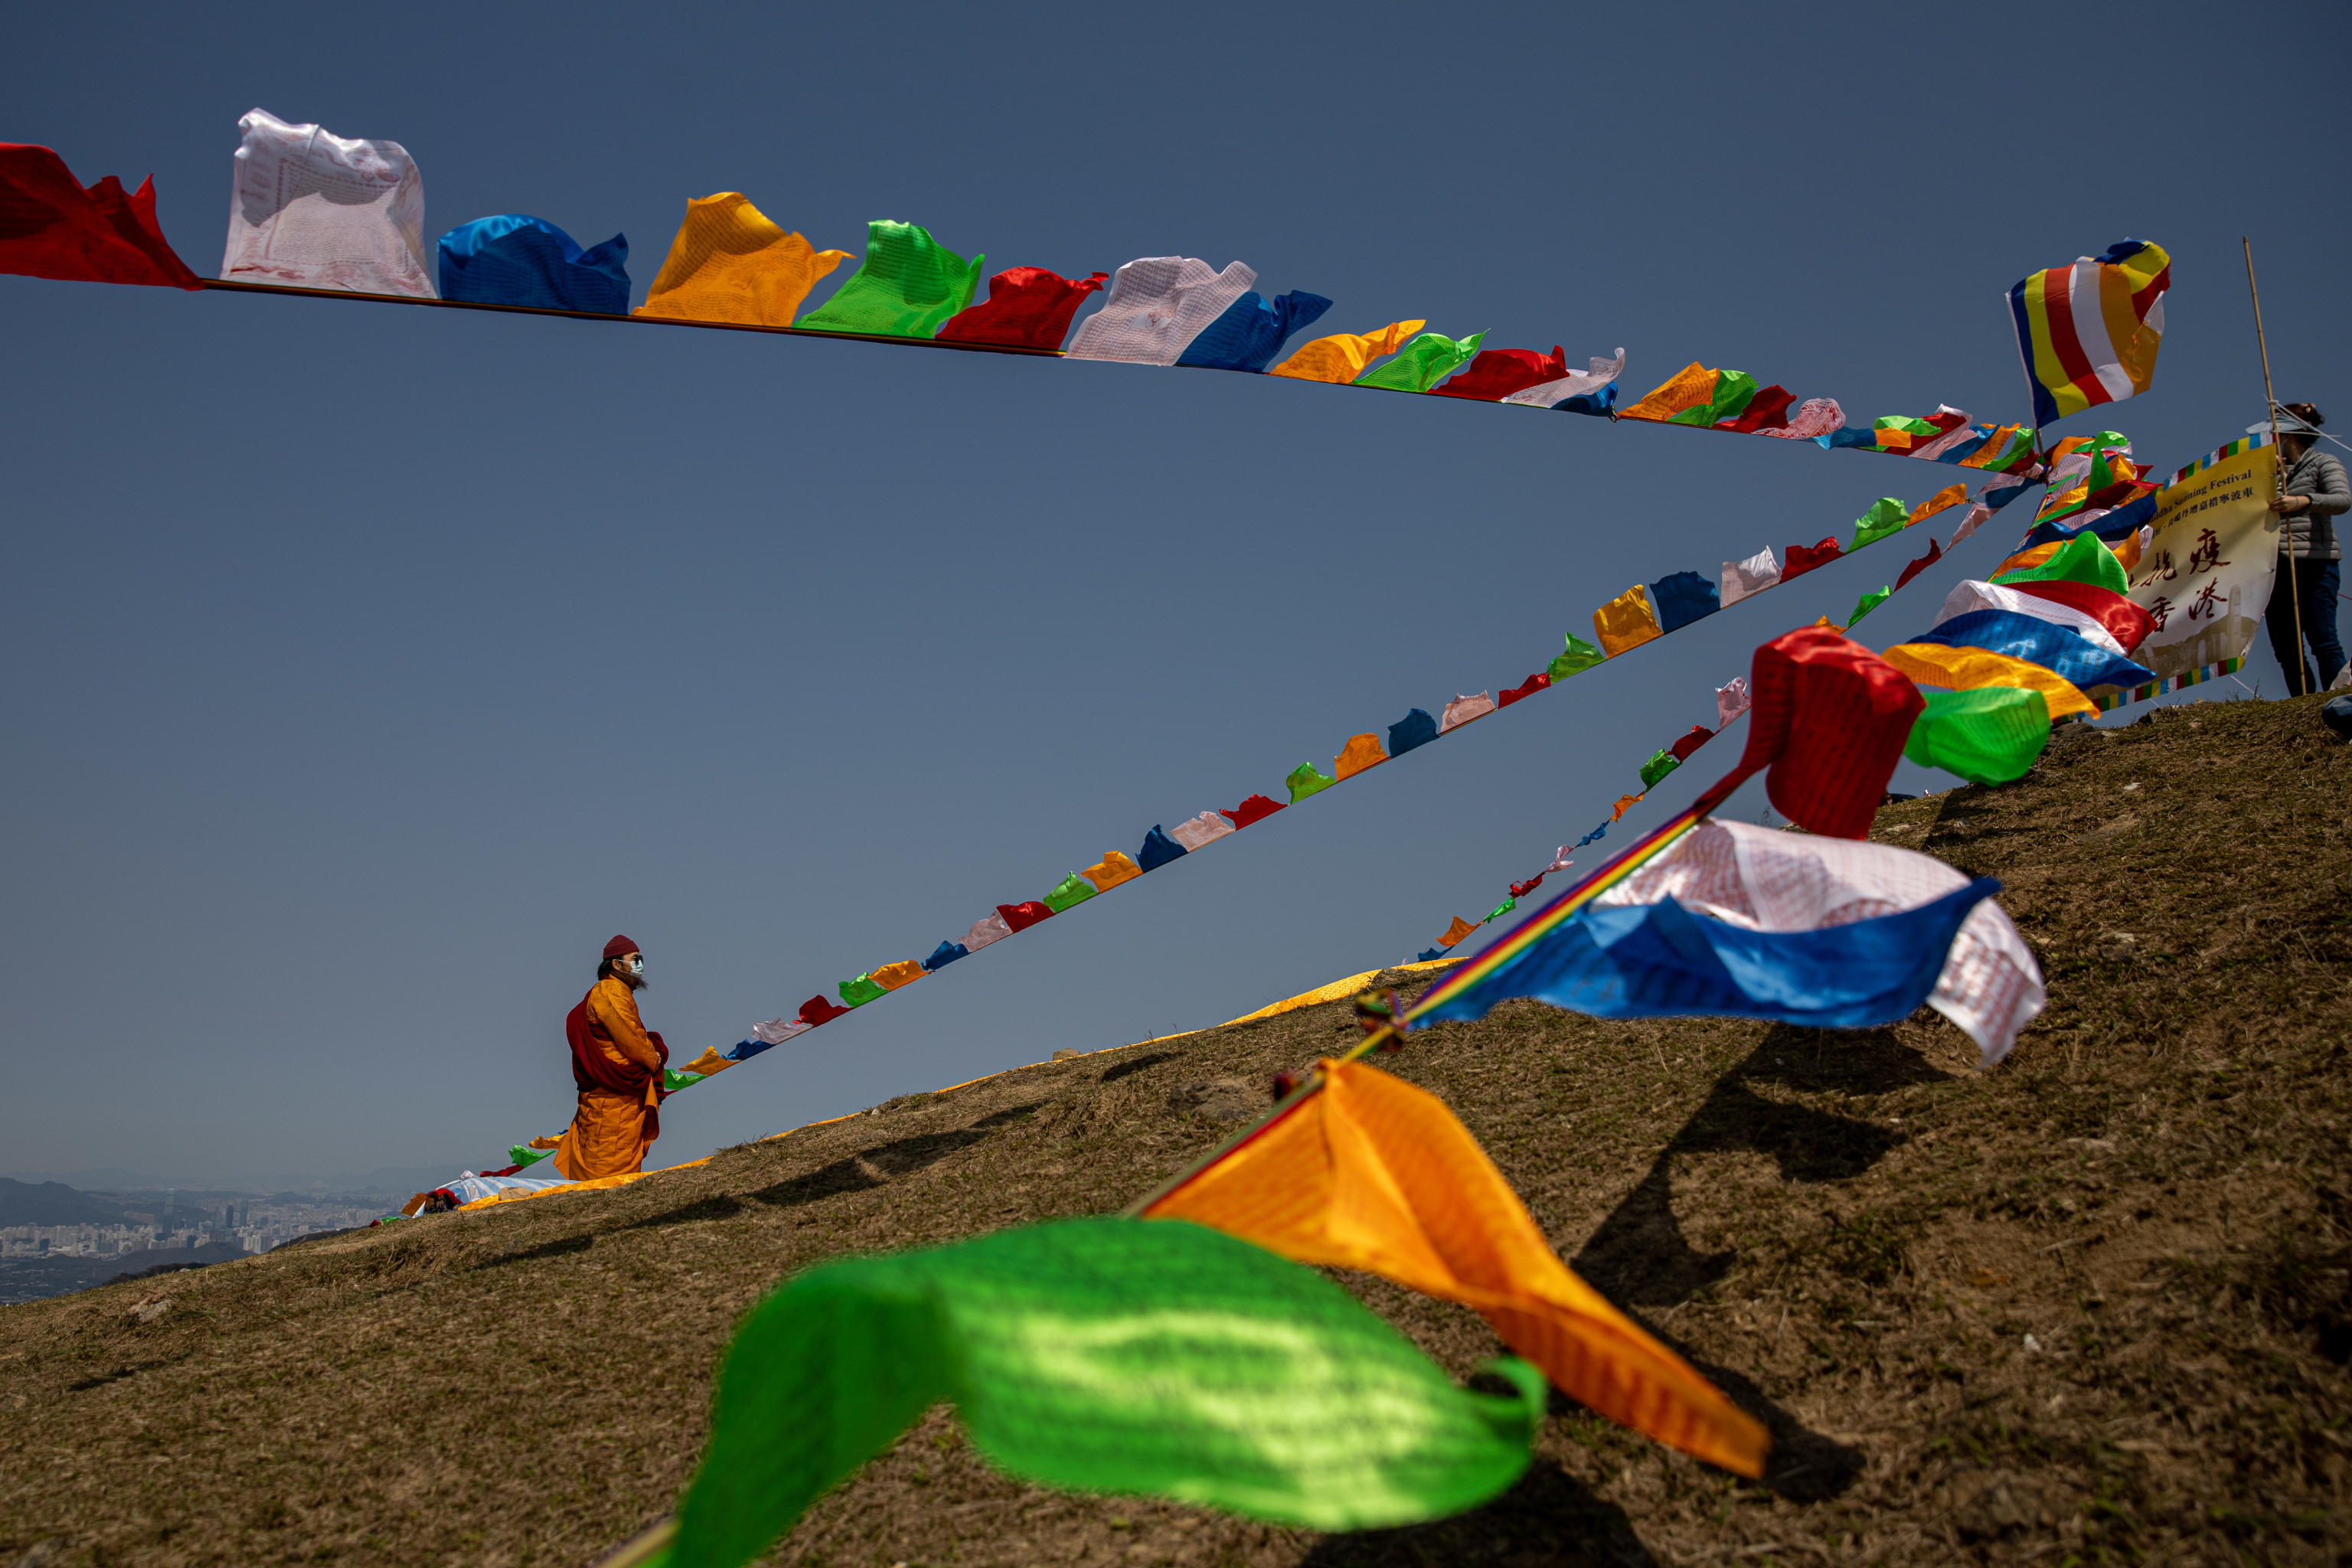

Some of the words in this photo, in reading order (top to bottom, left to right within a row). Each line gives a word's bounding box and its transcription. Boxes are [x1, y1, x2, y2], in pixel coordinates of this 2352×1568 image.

[2150, 505, 2173, 523] uddha
[2174, 486, 2207, 508] Sunning
[2210, 469, 2252, 491] Festival
[2128, 528, 2231, 588] 抗疫
[2148, 577, 2227, 632] 香港
